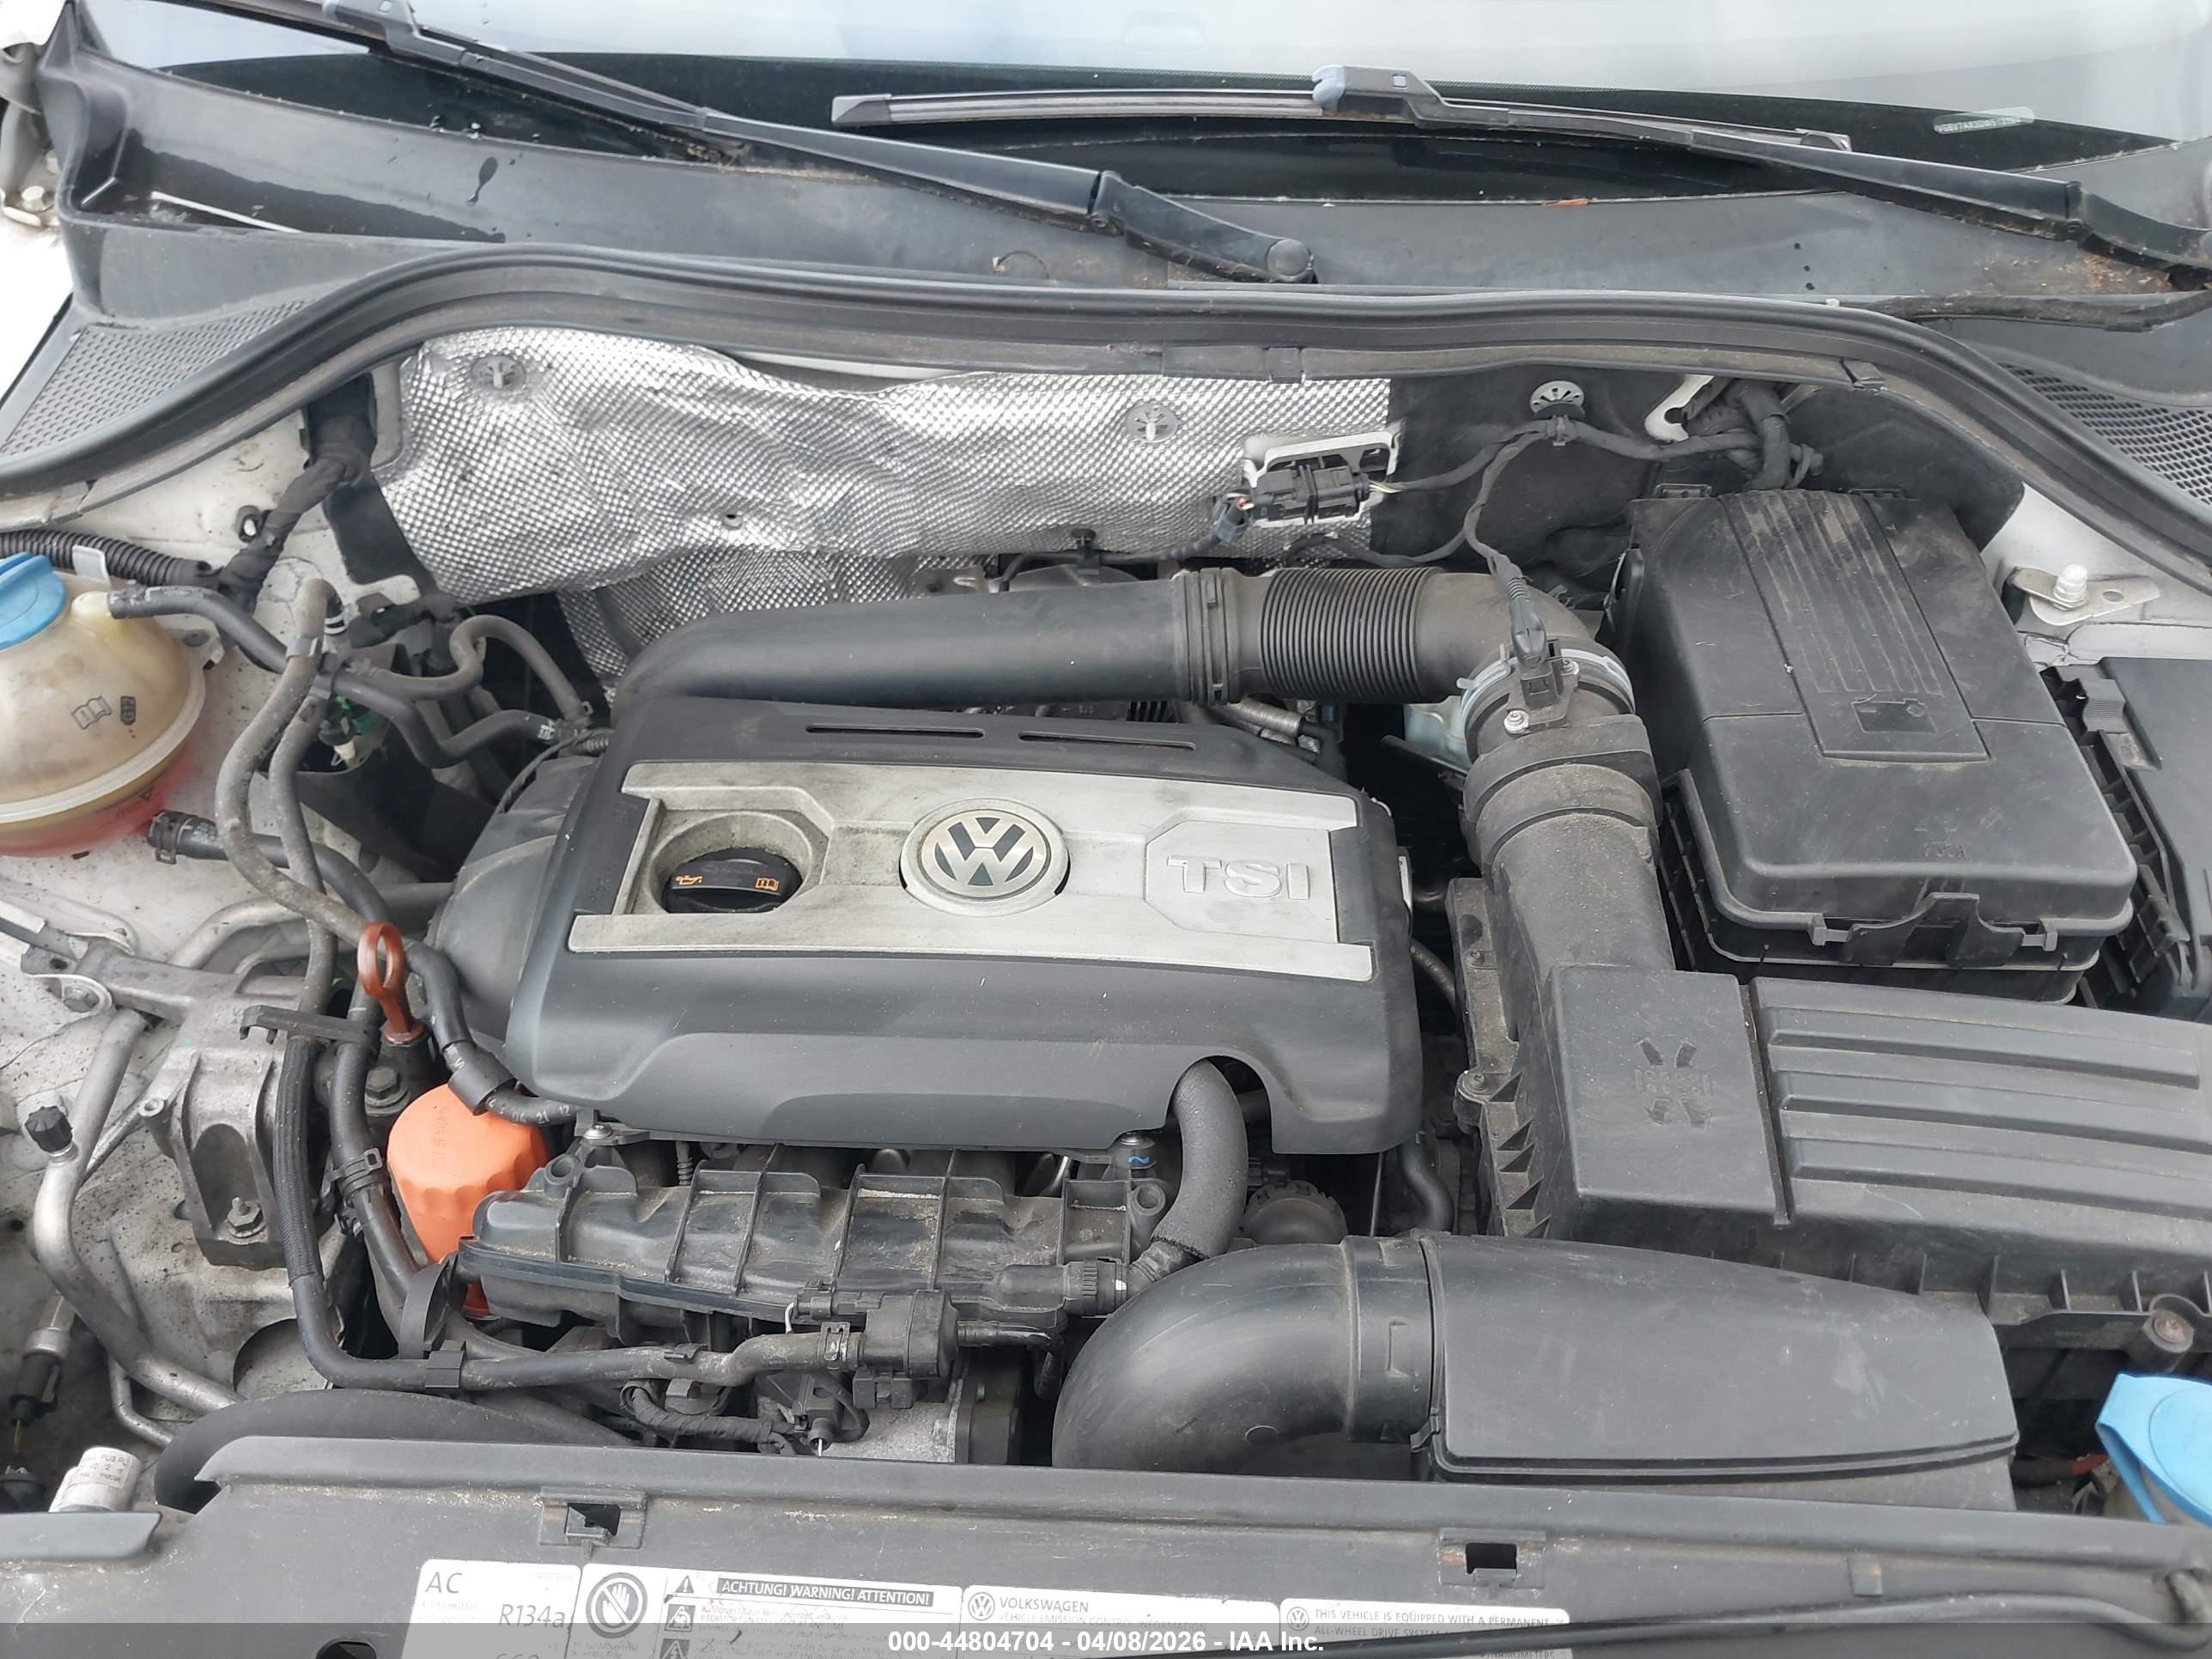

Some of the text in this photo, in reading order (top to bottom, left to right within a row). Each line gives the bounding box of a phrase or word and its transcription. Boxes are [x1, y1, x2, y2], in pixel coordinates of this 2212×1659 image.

[1167, 854, 1310, 900] TSI
[425, 1571, 463, 1594] AC
[721, 1580, 930, 1606] ACHTUNG! WARNING! ATTENTION!
[1000, 1596, 1089, 1613] VOLKSWAGEN
[498, 1603, 565, 1628] R134a
[999, 1612, 1207, 1632] VEHICLE EMISSION CONTROL INFORMATION
[1315, 1609, 1336, 1620] THIS
[1340, 1609, 1379, 1621] VEHICLE
[1383, 1612, 1392, 1621] IS
[1396, 1613, 1444, 1624] EQUIPPED
[1449, 1614, 1474, 1626] WITH
[1478, 1616, 1486, 1626] A
[1489, 1617, 1549, 1629] PERMANENT
[1314, 1626, 1368, 1637] ALL-WHEEL
[1371, 1627, 1401, 1638] DRIVE
